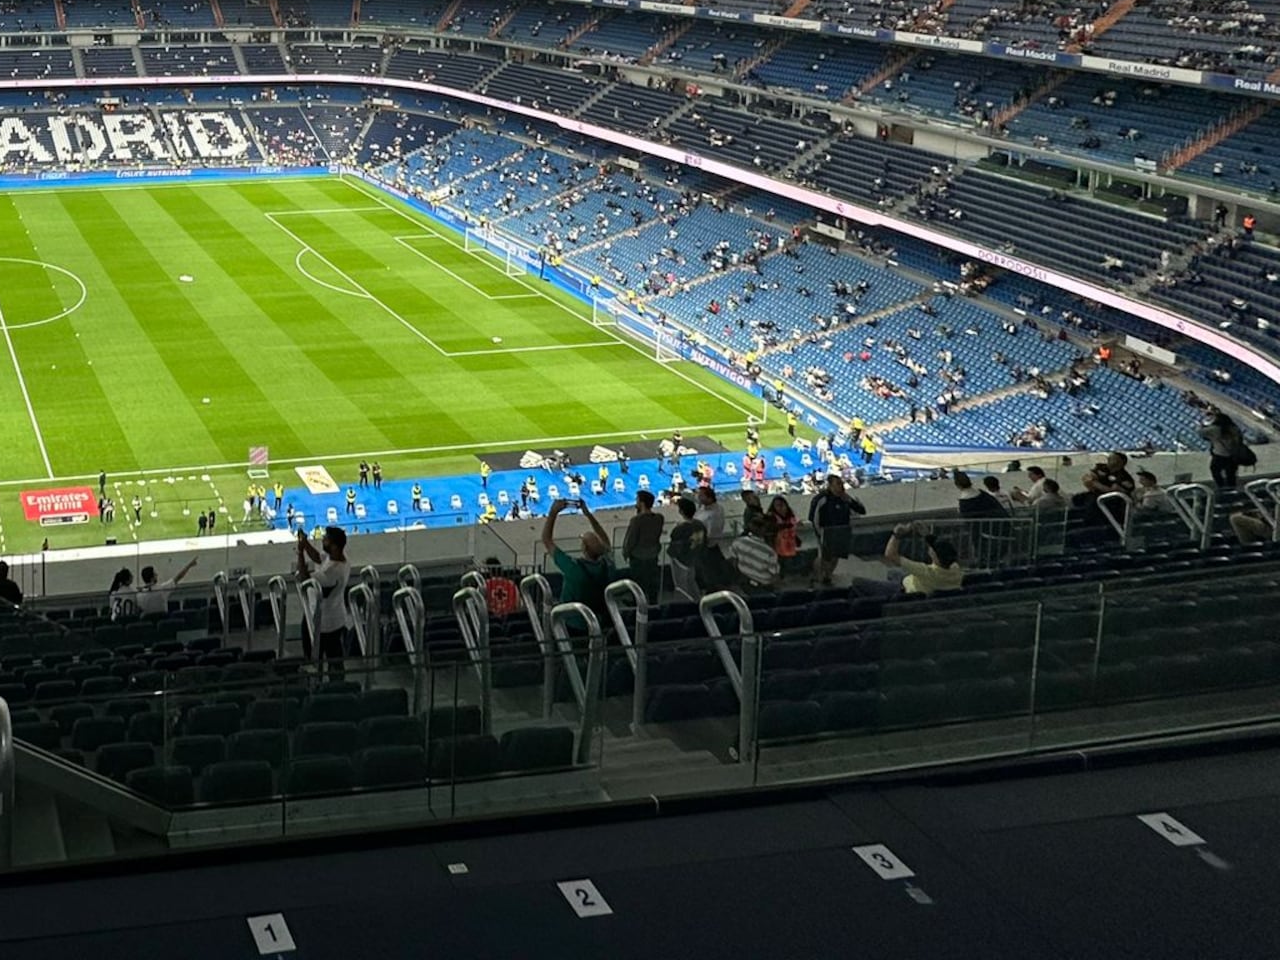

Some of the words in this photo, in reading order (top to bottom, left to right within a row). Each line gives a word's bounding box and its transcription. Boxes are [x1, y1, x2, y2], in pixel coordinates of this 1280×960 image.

[1005, 46, 1024, 58] Real
[1026, 49, 1056, 62] Madrid
[1109, 62, 1131, 73] Real
[1133, 66, 1170, 78] Madrid
[1234, 78, 1262, 91] Real
[26, 492, 90, 506] Emirates
[1161, 820, 1184, 837] 4
[871, 852, 895, 871] 3
[575, 888, 596, 908] 2
[264, 923, 278, 943] 1
